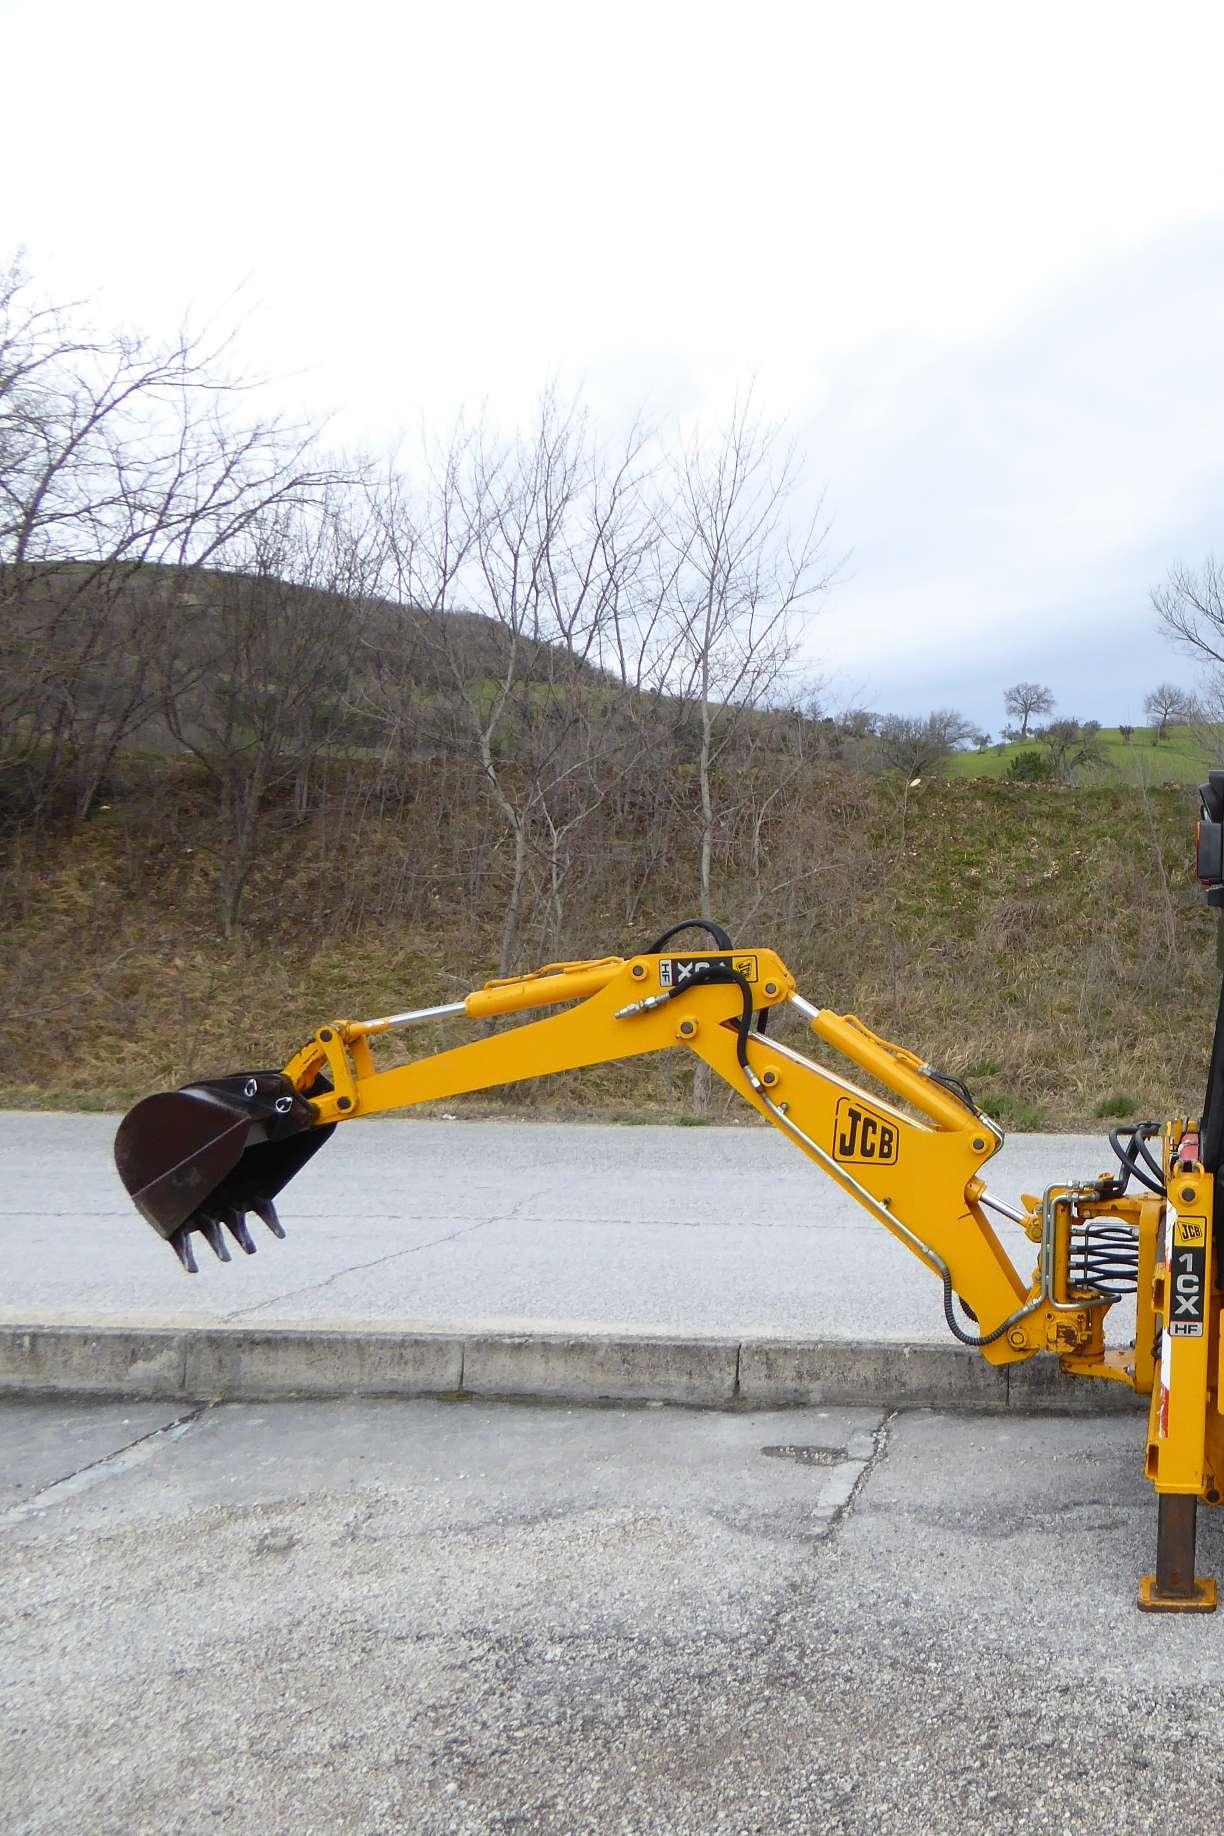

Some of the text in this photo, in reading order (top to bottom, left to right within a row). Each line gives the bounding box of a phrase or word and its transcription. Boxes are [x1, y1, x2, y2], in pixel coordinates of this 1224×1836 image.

[661, 963, 670, 984] HF
[839, 1107, 894, 1159] JCB
[1181, 1223, 1201, 1240] JCB
[1174, 1324, 1198, 1335] HF
